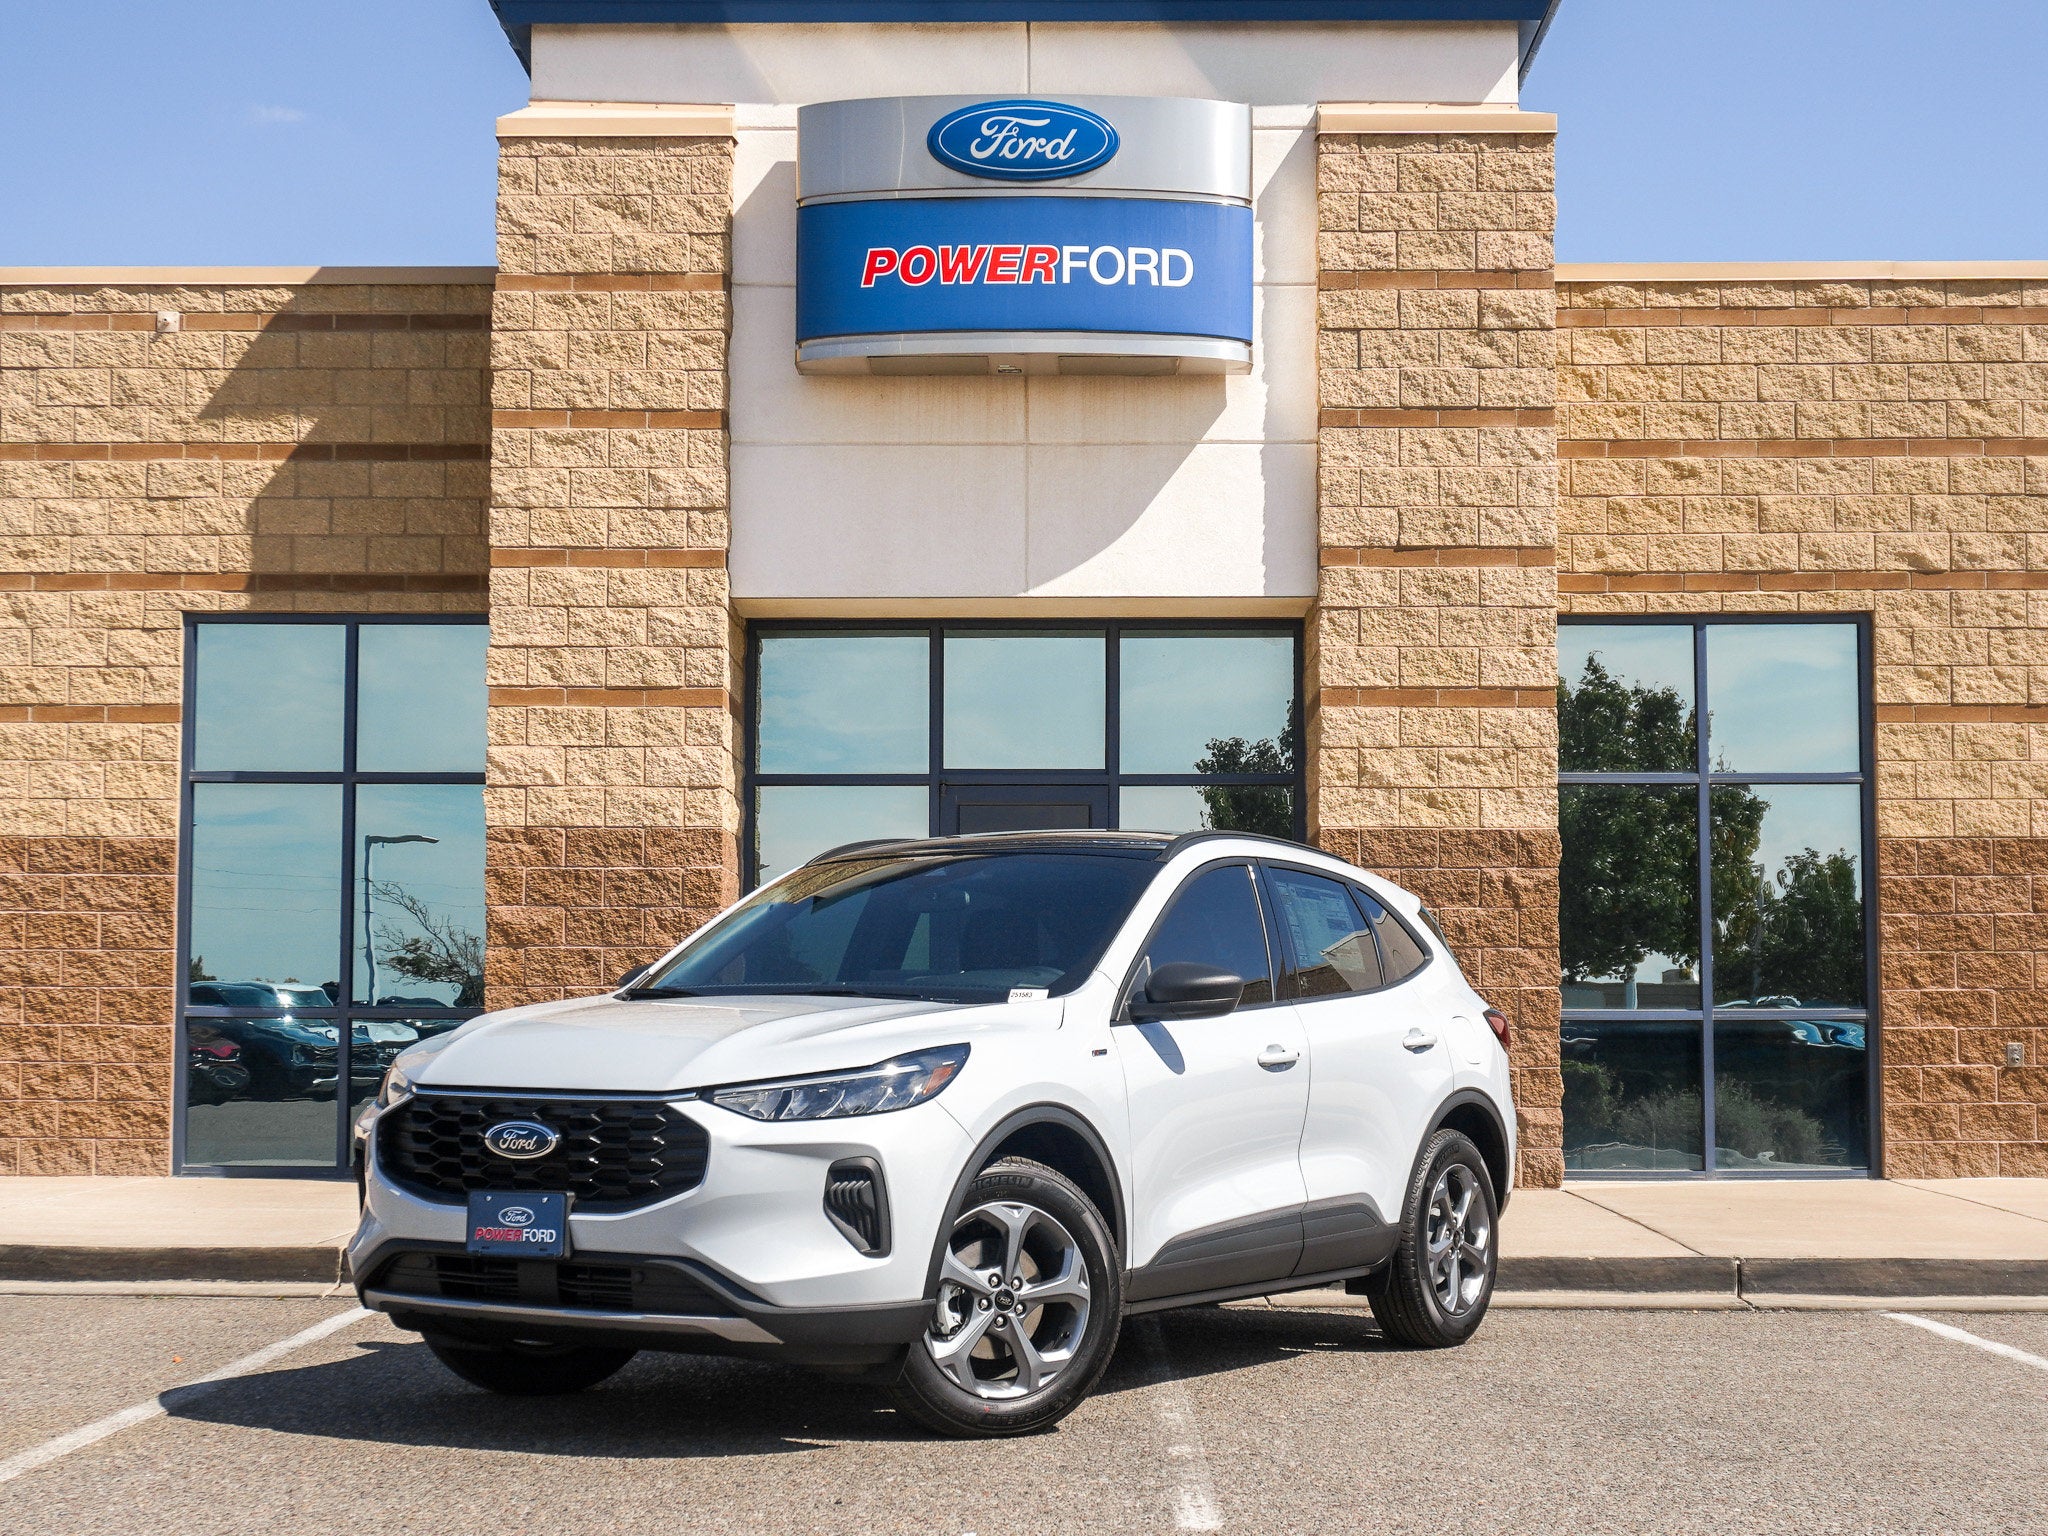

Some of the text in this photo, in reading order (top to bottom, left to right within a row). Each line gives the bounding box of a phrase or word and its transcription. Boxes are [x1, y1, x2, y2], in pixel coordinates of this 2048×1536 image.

[970, 116, 1077, 160] Ford
[860, 244, 1194, 288] POWERFORD
[499, 1129, 537, 1150] Ford
[505, 1210, 527, 1222] Ford
[476, 1227, 556, 1242] POWERFORD
